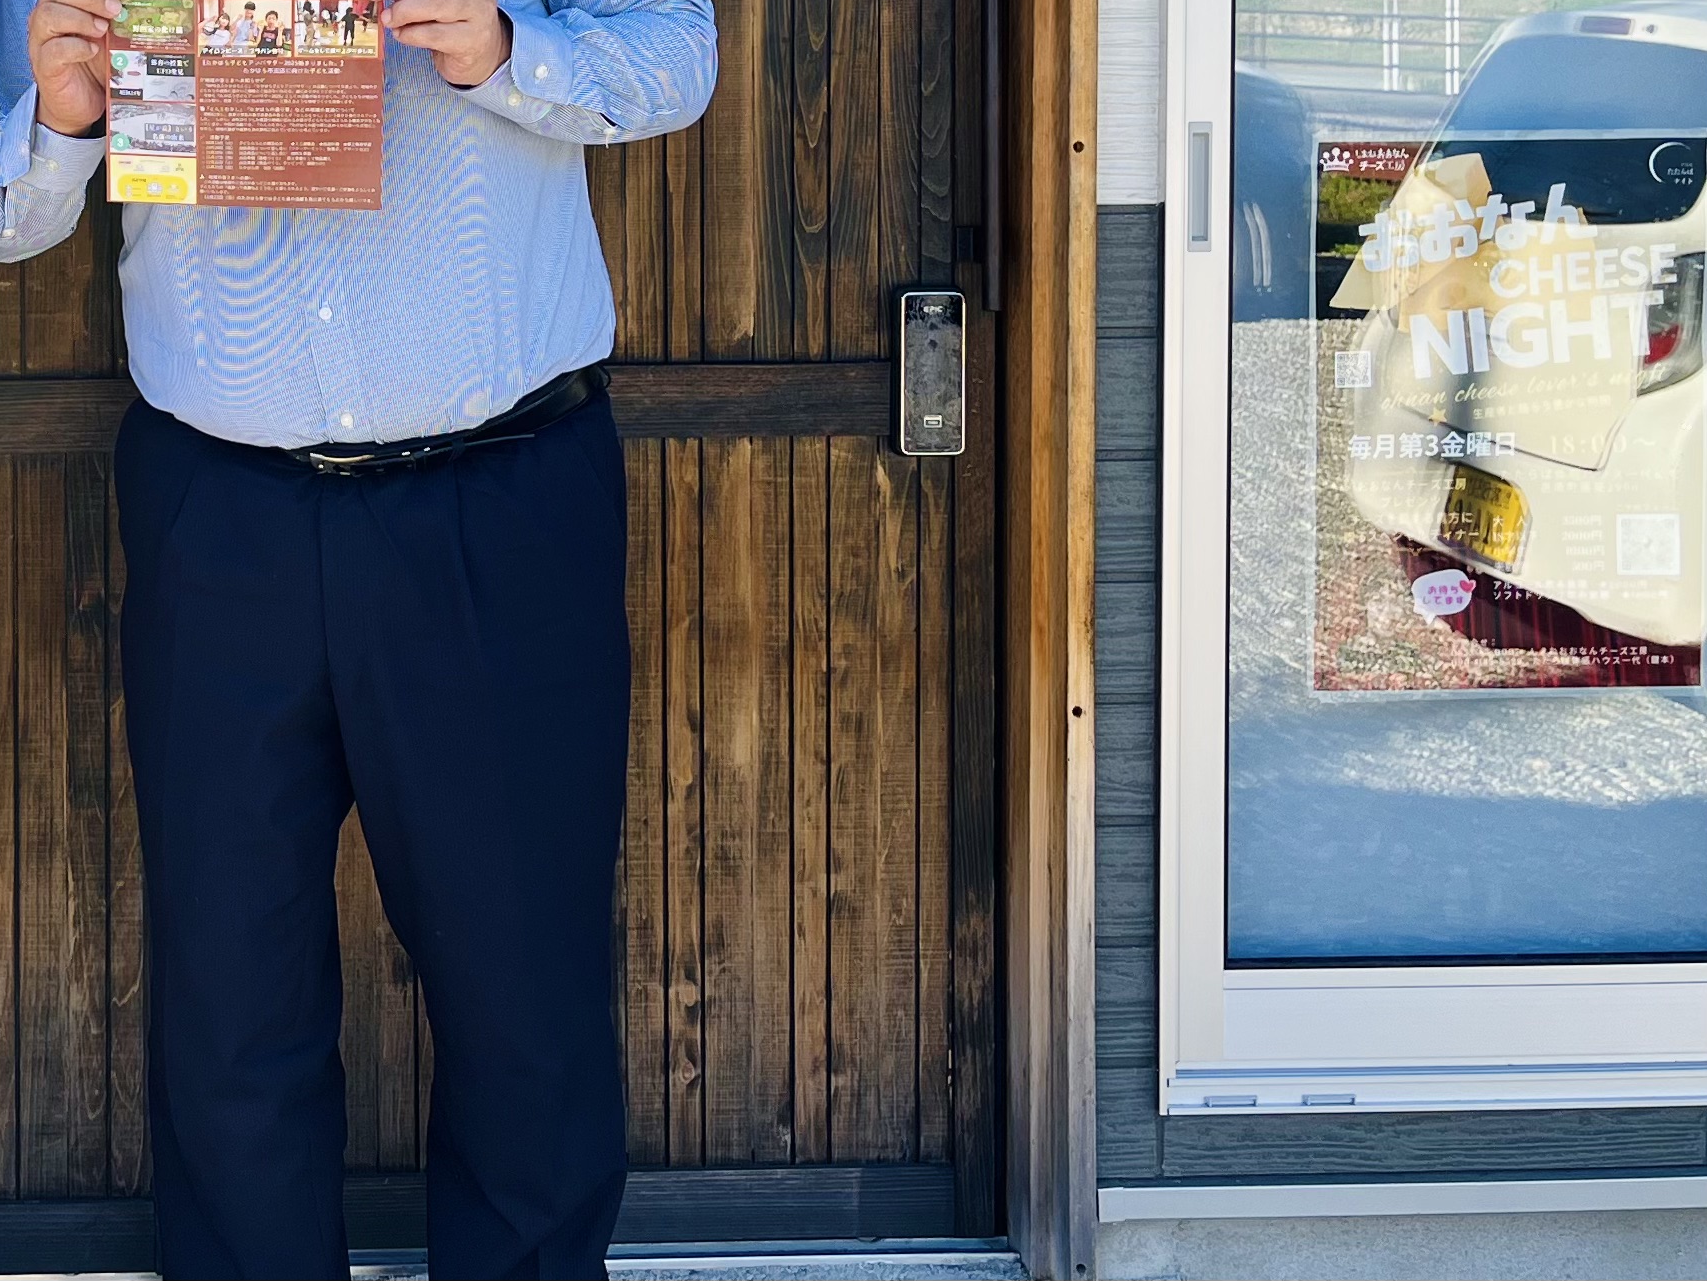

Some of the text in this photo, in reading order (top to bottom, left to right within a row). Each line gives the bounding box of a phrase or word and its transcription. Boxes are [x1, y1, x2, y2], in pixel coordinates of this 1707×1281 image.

[116, 57, 124, 67] 2
[117, 138, 124, 147] 3
[1358, 182, 1598, 272] おおなん
[1488, 243, 1678, 299] CHEESE
[1409, 289, 1665, 380] NIGHT
[1454, 381, 1519, 404] cheese
[1347, 431, 1517, 460] 毎月第3金曜日
